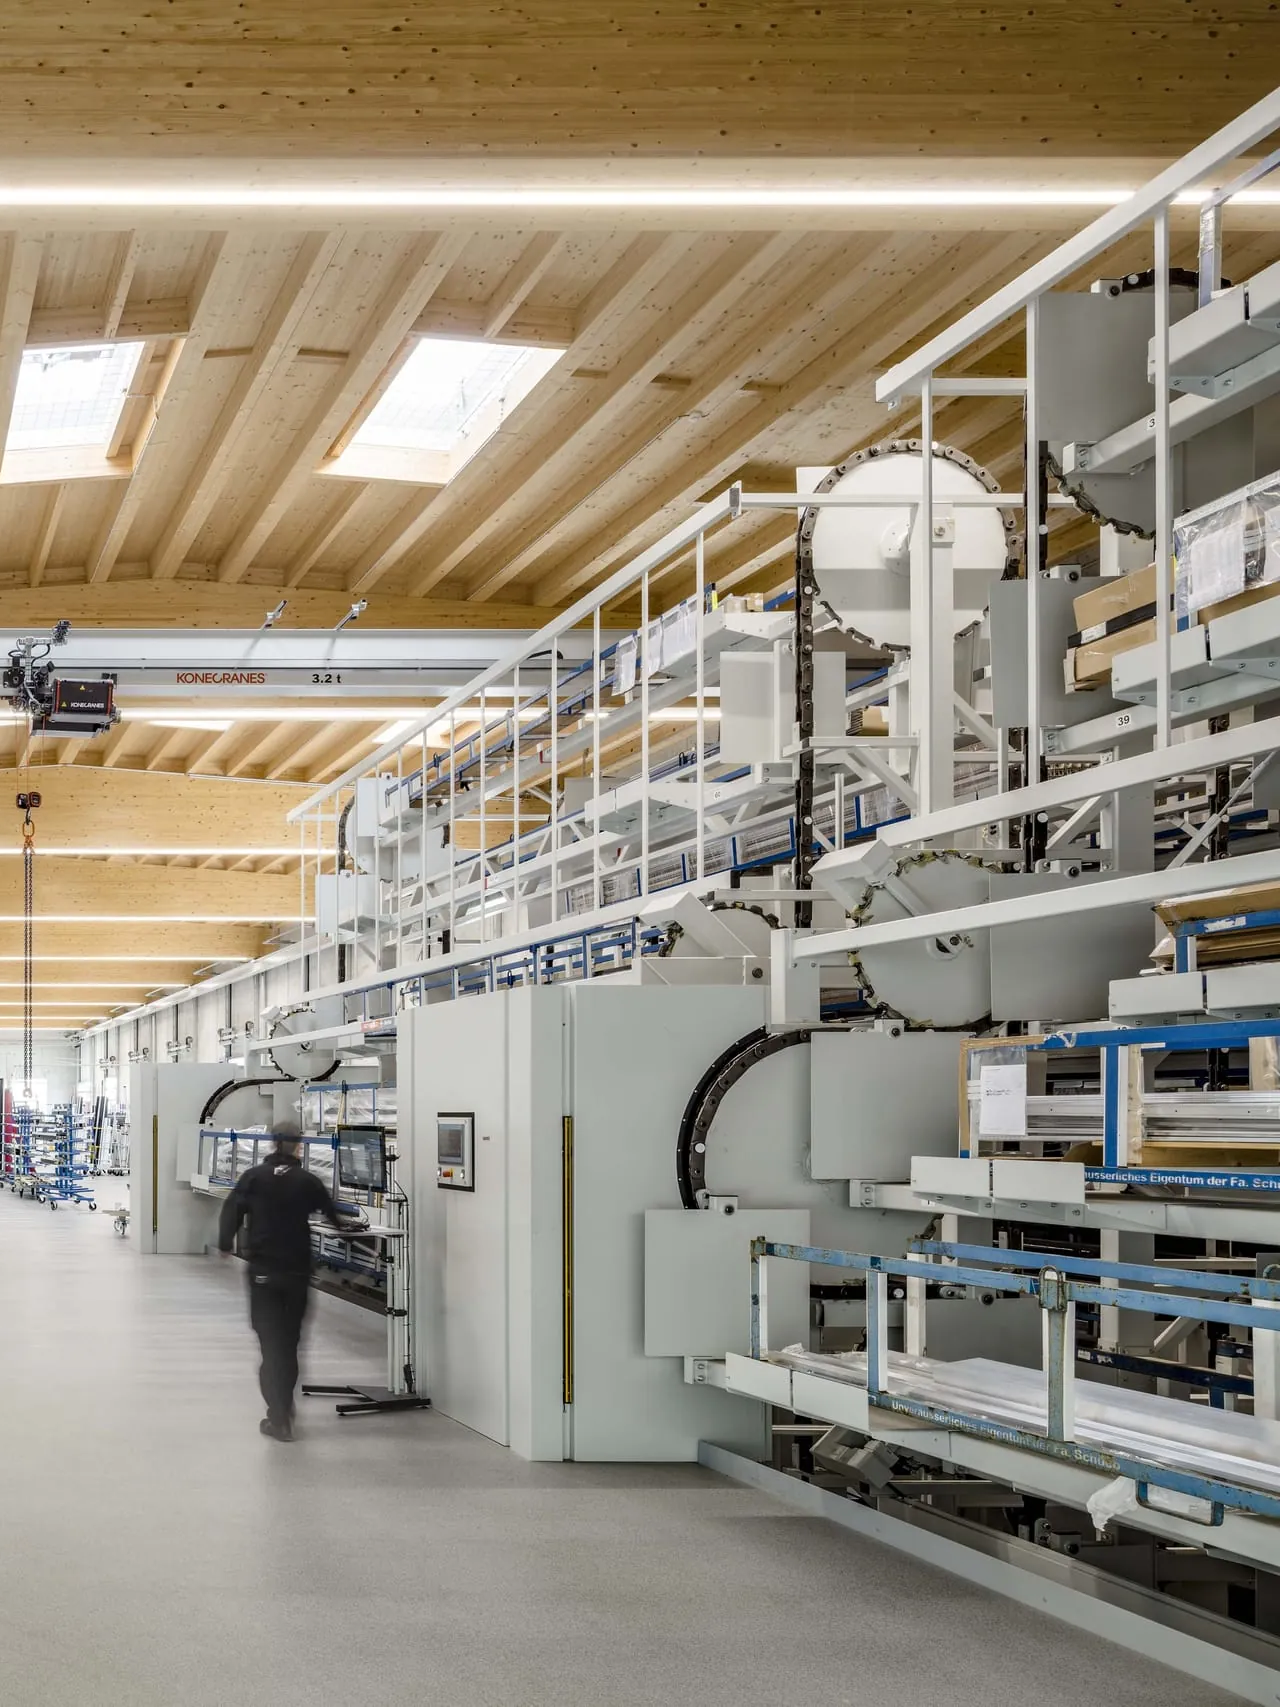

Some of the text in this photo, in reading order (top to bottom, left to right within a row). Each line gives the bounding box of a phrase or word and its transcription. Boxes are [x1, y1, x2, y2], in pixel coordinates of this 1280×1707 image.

[176, 672, 266, 684] KONECRANES
[311, 673, 342, 684] 3.2 t
[1117, 715, 1130, 726] 39
[1149, 1172, 1204, 1186] Eigentum
[1206, 1175, 1228, 1187] der
[1230, 1176, 1249, 1188] Fa.
